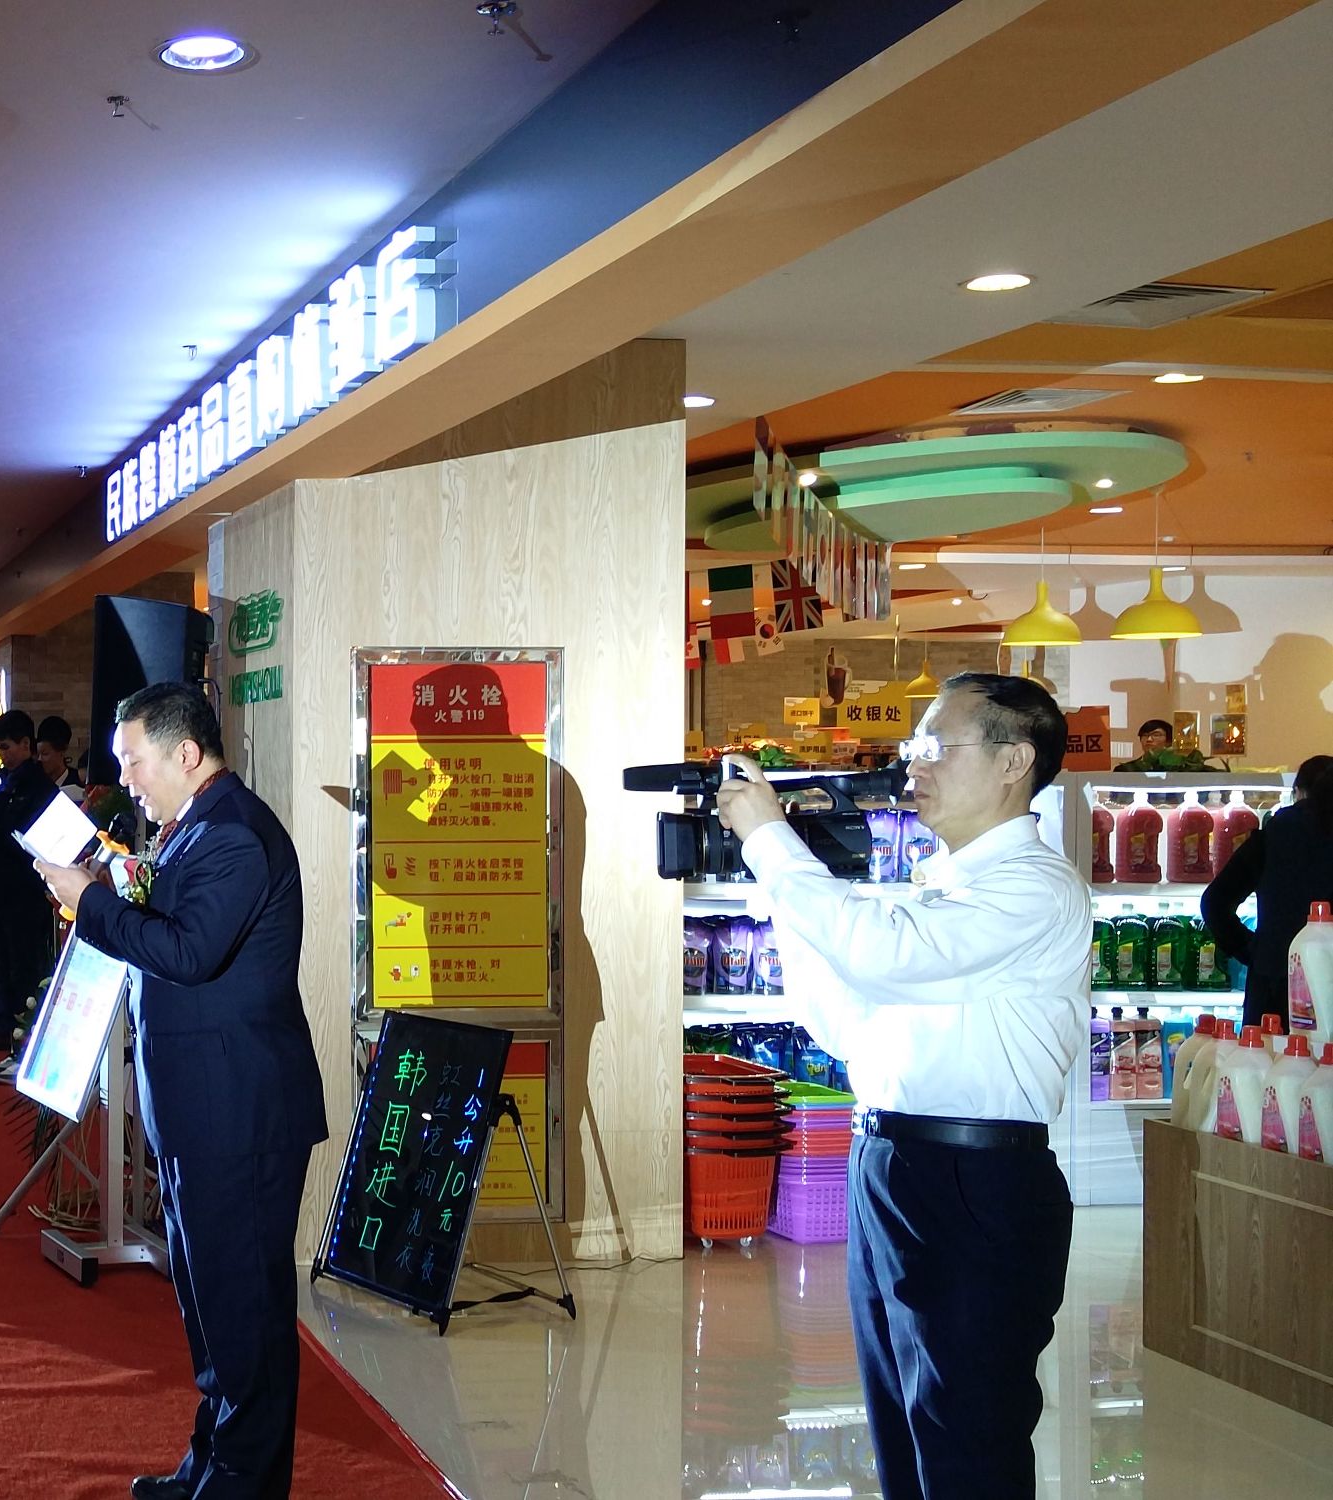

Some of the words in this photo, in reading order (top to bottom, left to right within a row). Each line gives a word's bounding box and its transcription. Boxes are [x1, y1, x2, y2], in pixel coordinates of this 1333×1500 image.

[415, 684, 502, 707] 消火栓
[434, 709, 485, 723] 火警119
[846, 705, 901, 721] 收银处
[424, 758, 482, 771] 使用说明
[429, 912, 491, 922] 逆时针方向
[359, 1049, 427, 1251] 韩国进口
